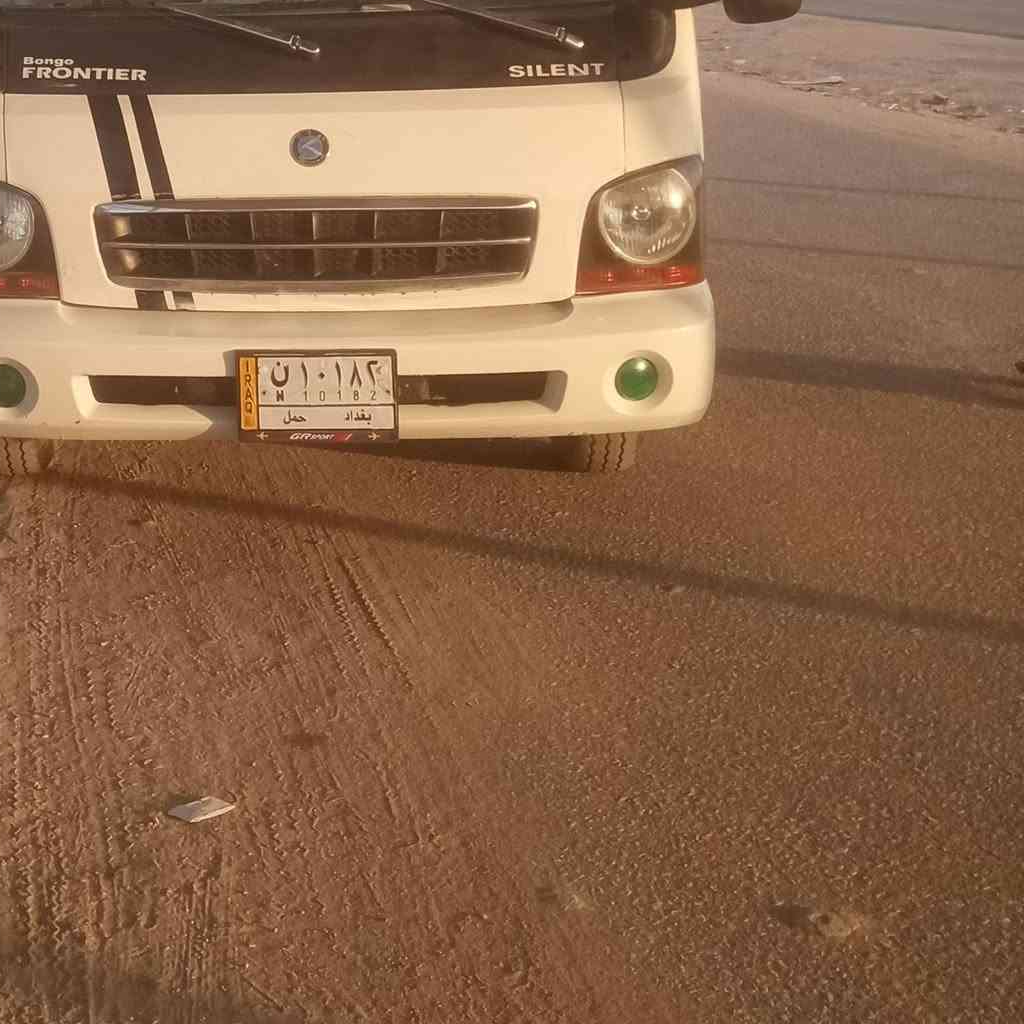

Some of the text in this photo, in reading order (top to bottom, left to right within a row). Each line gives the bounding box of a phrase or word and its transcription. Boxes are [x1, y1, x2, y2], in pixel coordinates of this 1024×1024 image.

[23, 56, 75, 67] Bongo
[22, 67, 148, 81] FRONTIER
[508, 63, 605, 78] SILENT
[241, 359, 254, 414] IRAQ
[276, 390, 378, 402] N 10182
[283, 408, 373, 425] بغداد حمل
